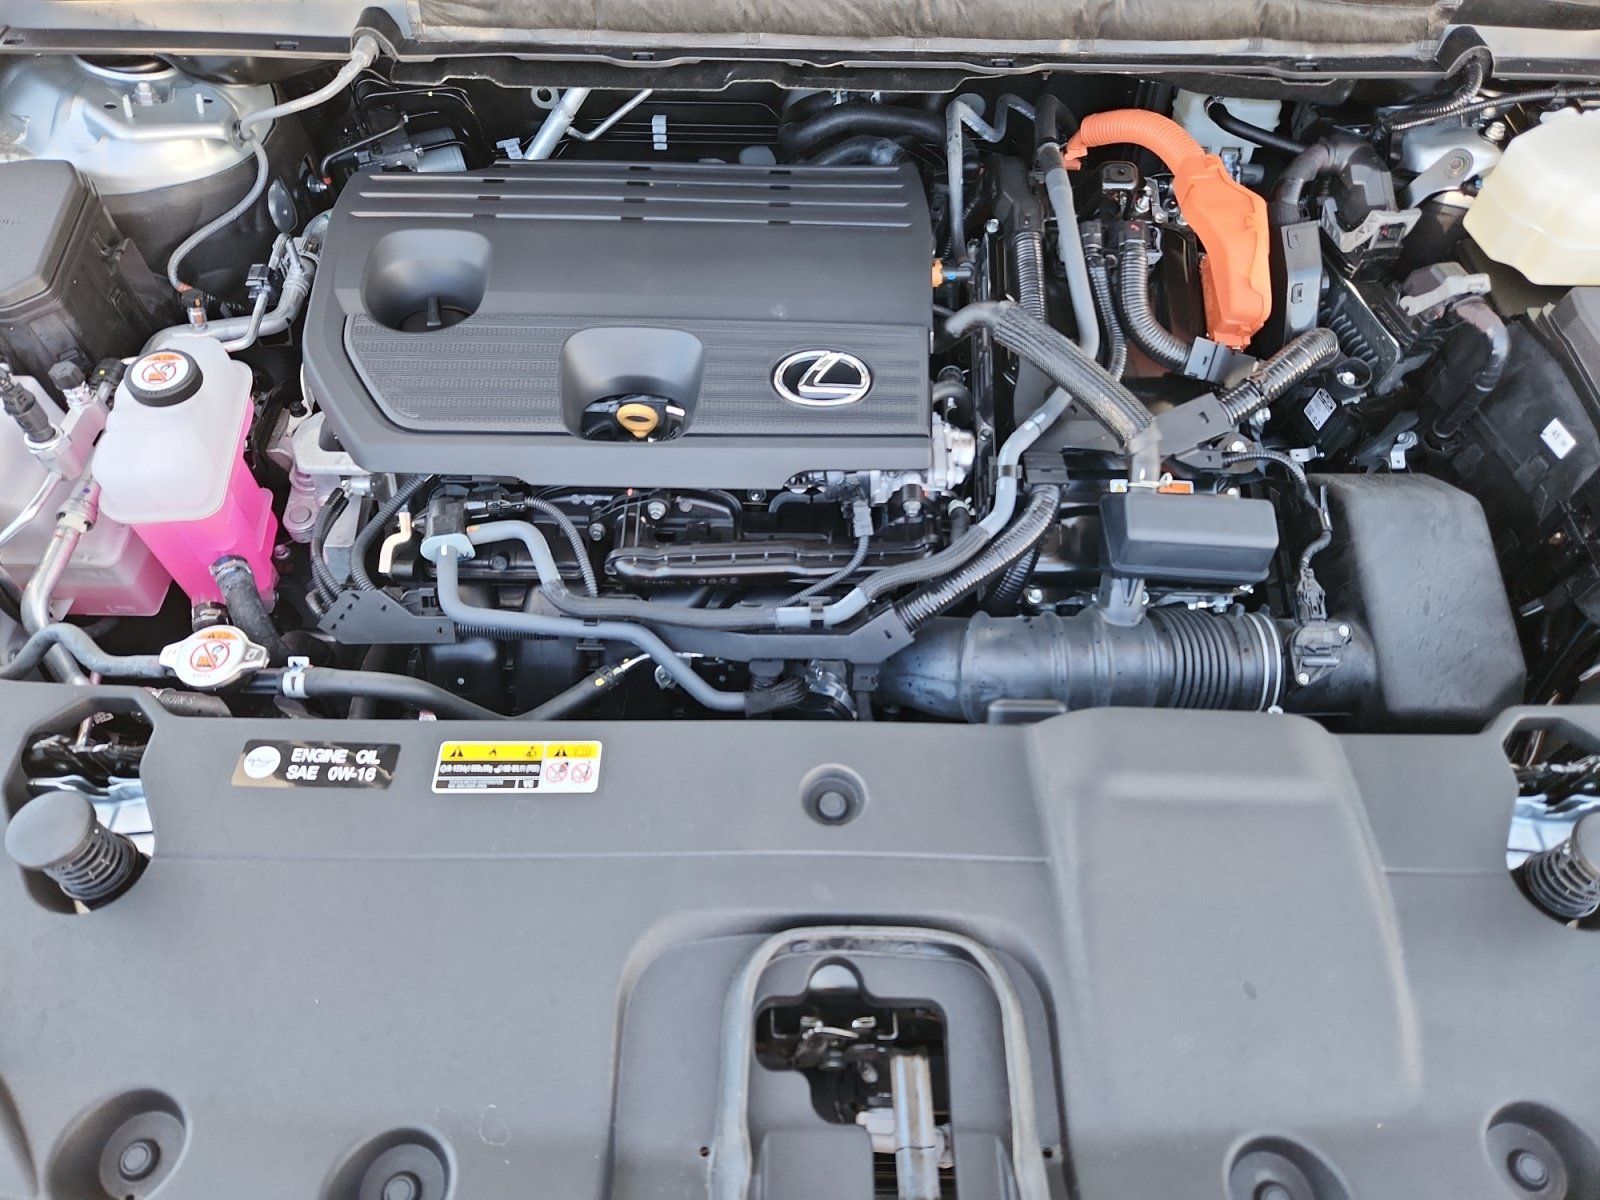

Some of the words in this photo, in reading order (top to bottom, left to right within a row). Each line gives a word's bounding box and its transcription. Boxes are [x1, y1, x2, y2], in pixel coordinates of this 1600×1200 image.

[291, 748, 349, 764] ENGINE
[355, 749, 381, 765] OIL
[286, 765, 320, 780] SAE
[327, 766, 377, 782] 0W-16
